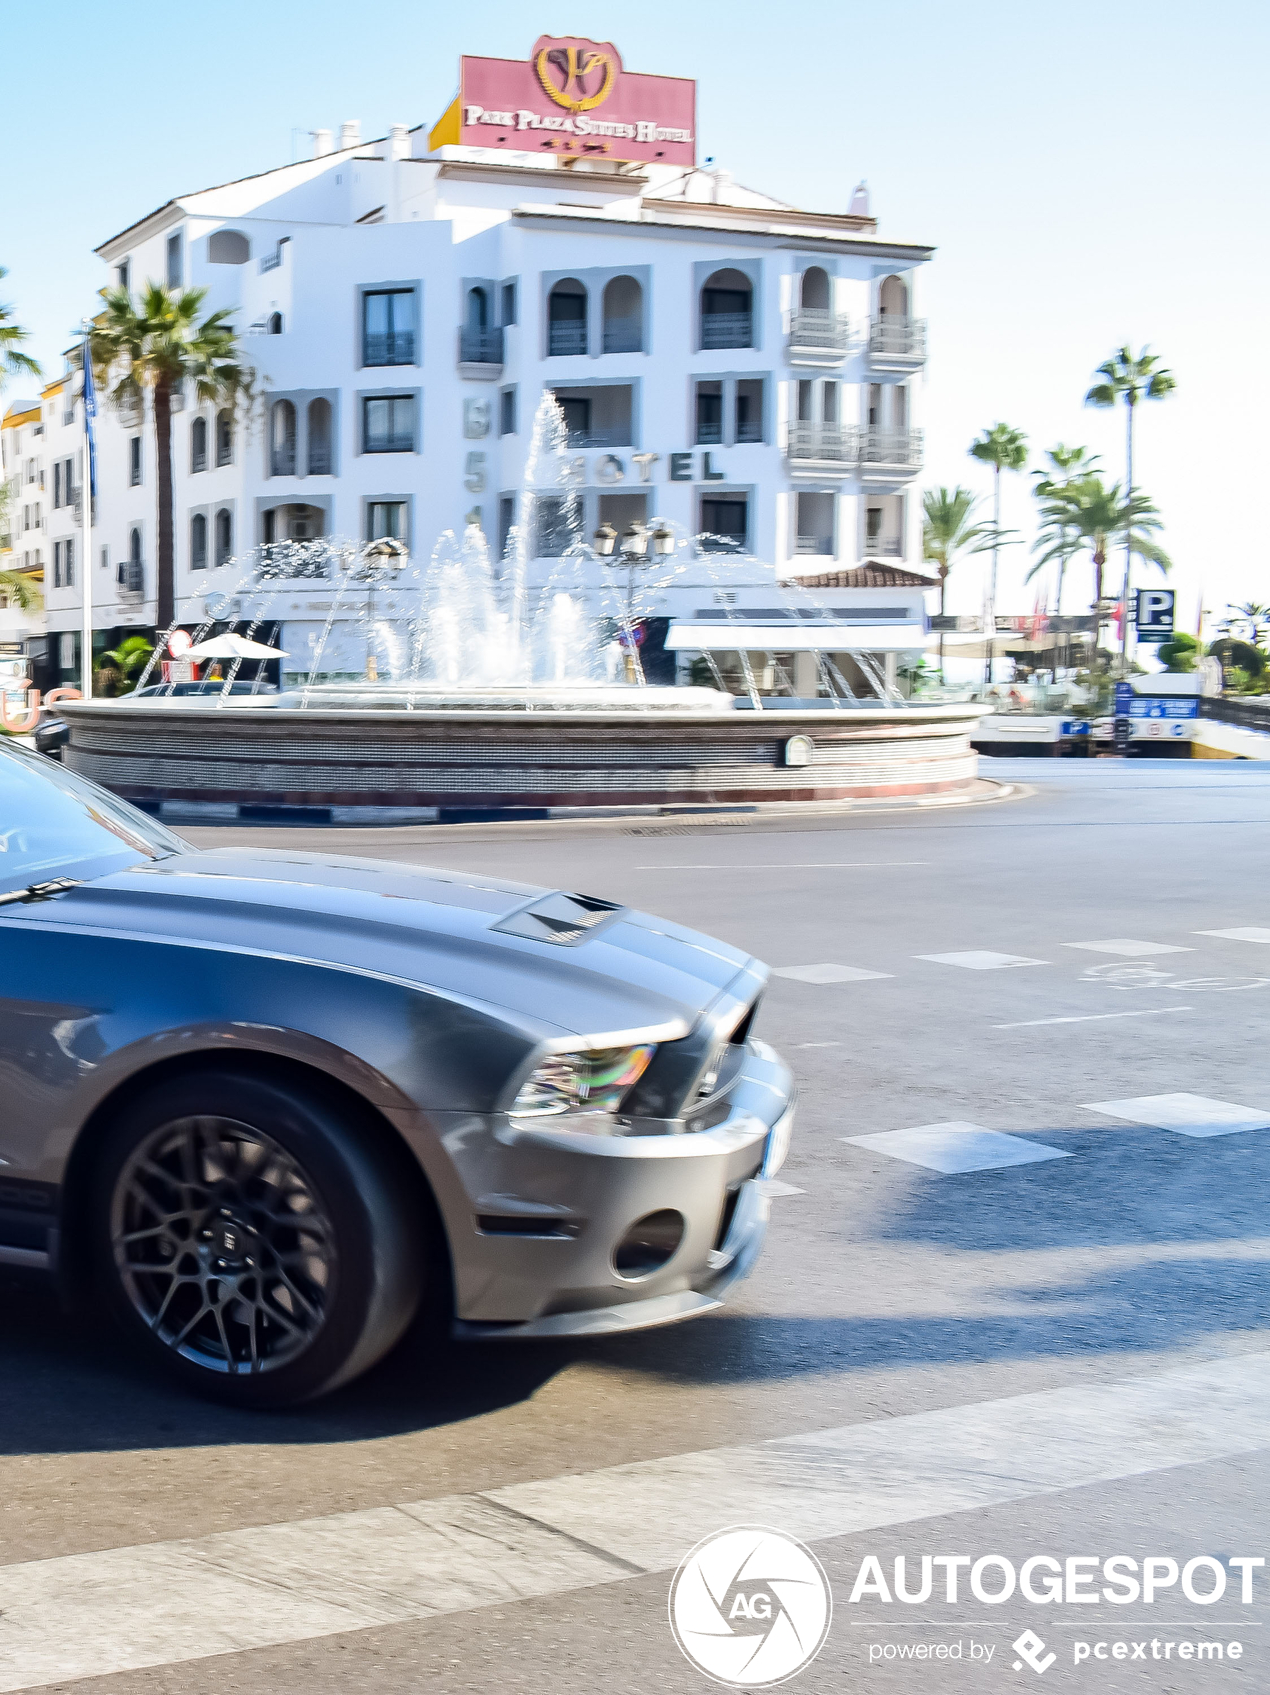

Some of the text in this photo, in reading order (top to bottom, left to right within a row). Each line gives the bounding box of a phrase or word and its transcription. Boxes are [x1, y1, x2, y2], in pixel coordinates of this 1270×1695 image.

[463, 104, 515, 126] PARK
[515, 109, 573, 132] PLAZA
[635, 120, 693, 142] HOTEL
[1140, 590, 1173, 624] P
